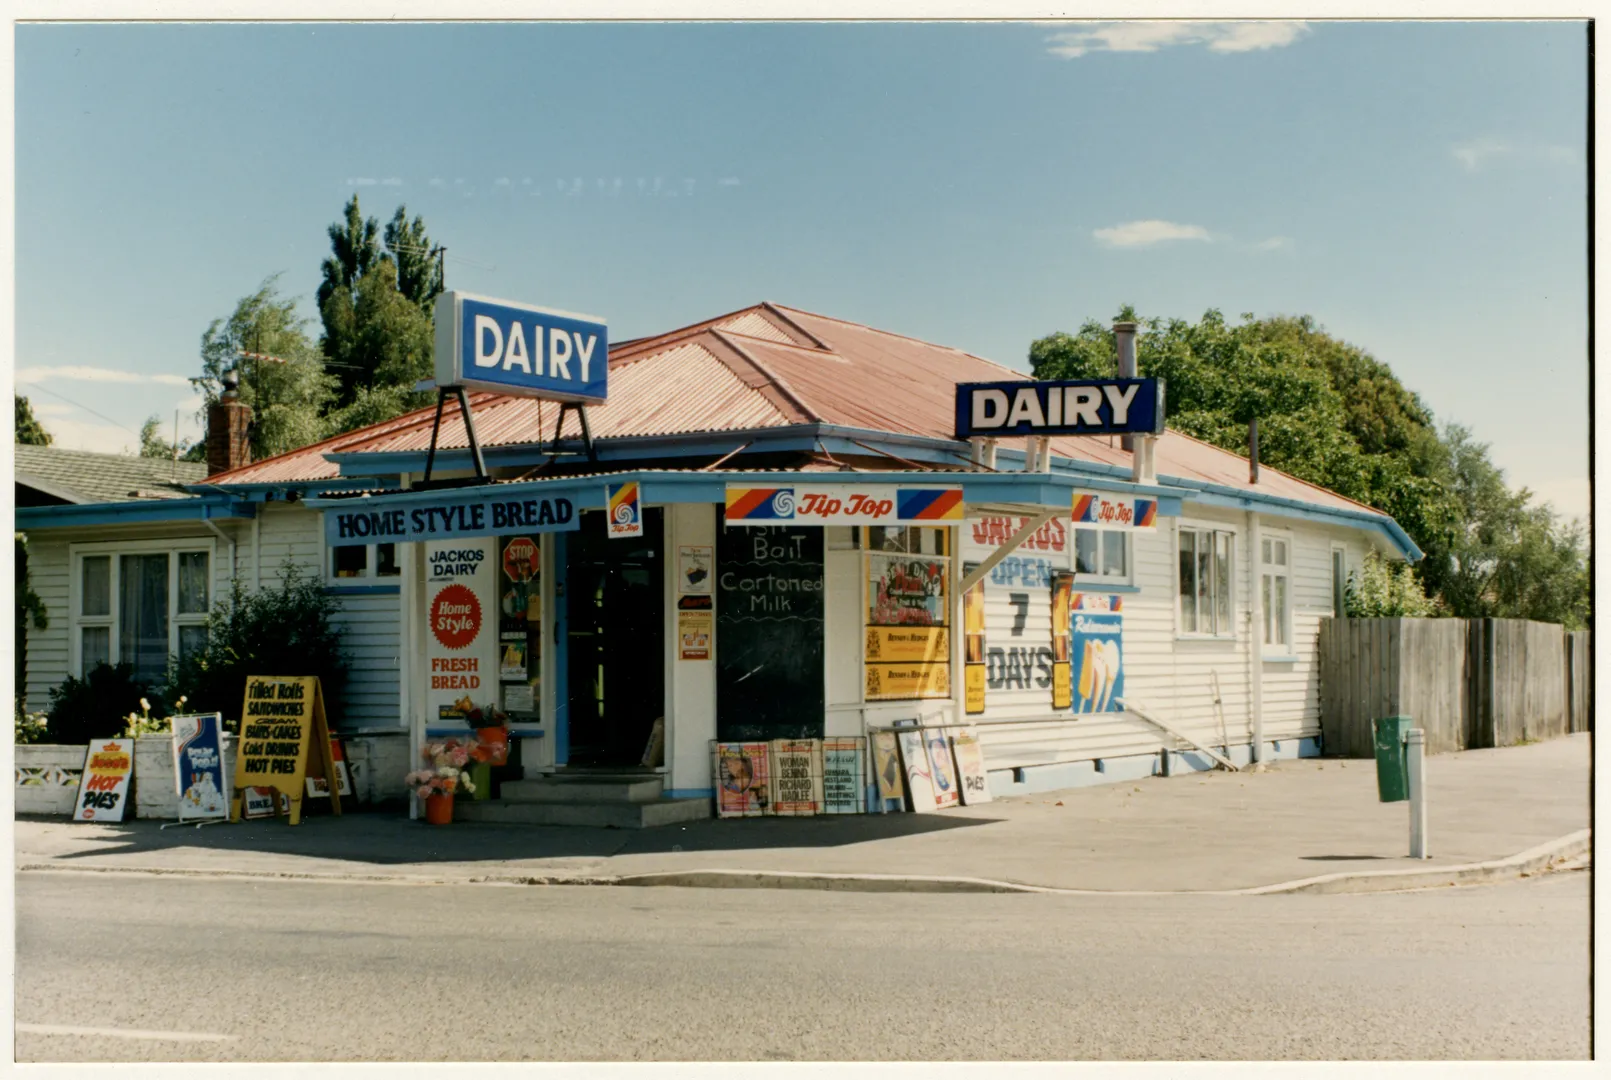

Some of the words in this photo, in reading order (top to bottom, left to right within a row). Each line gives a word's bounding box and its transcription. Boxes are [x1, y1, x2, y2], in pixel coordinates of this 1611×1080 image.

[475, 314, 597, 383] DAIRY
[971, 384, 1140, 429] DAIRY
[797, 494, 842, 518] Tip
[843, 494, 893, 518] Top
[1098, 501, 1115, 523] Tip
[1115, 503, 1133, 524] Top
[337, 509, 405, 538] HOME
[411, 502, 485, 534] STYLE
[491, 497, 573, 529] BREAD
[611, 525, 625, 533] Tip
[625, 524, 639, 532] Top
[429, 549, 485, 563] JACKOS
[509, 545, 534, 560] STOP
[434, 563, 479, 576] DAIRY
[991, 557, 1051, 587] OPEN
[720, 572, 823, 592] Cartoned
[438, 602, 472, 615] Home
[750, 595, 792, 612] Milk
[1008, 593, 1030, 636] 7
[436, 616, 474, 635] Style
[431, 658, 478, 672] FRESH
[986, 647, 1052, 690] DAYS
[431, 675, 480, 690] BREAD
[247, 702, 304, 716] SANDWICHES
[265, 742, 300, 756] DRINKS
[245, 759, 270, 773] HOT
[271, 759, 296, 773] PIES
[779, 757, 809, 768] WOMAN
[781, 768, 808, 779] BEHIND
[86, 774, 124, 791] HOT
[779, 780, 812, 791] RICHARD
[965, 776, 984, 791] PIES
[82, 791, 120, 810] PIES
